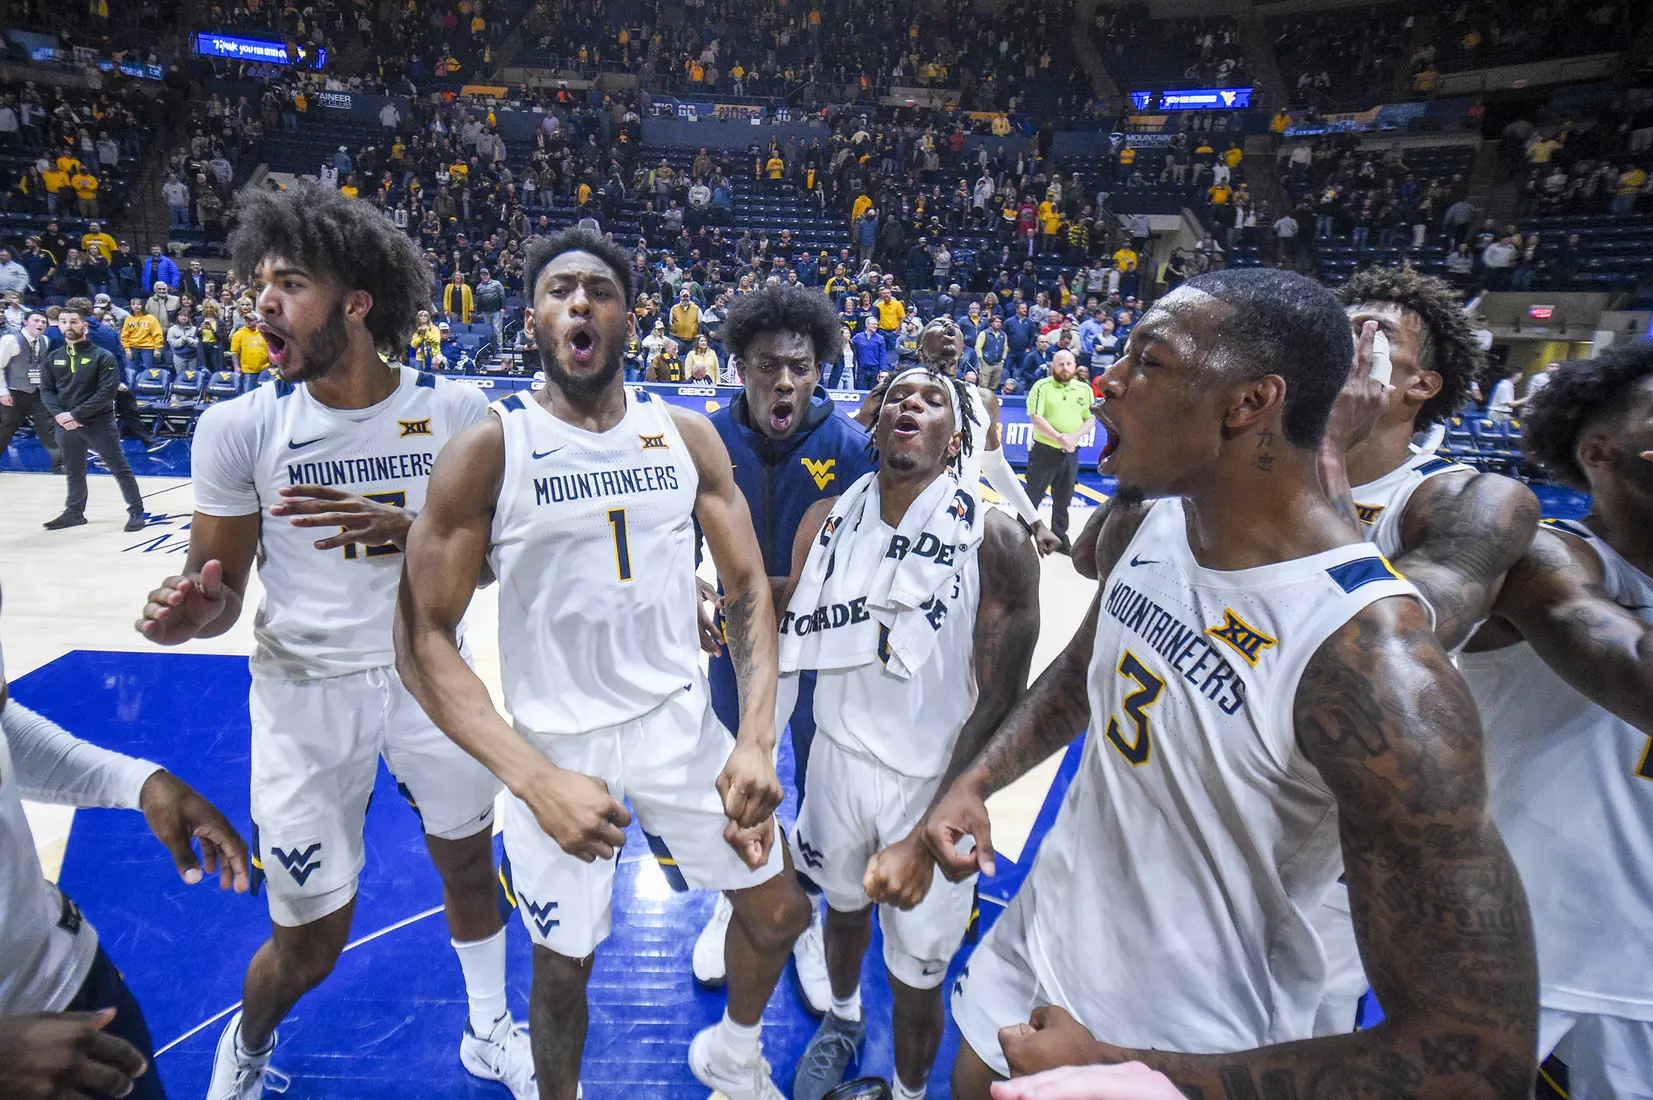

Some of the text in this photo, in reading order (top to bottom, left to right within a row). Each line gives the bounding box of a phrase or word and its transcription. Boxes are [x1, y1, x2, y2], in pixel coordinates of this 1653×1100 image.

[678, 387, 716, 396] GEICO
[288, 453, 433, 486] MOUNTAINEERS
[533, 465, 678, 506] MOUNTAINEERS
[606, 507, 633, 582] 1
[1105, 580, 1246, 715] MOUNTAINEERS
[1205, 608, 1279, 667] XII
[1106, 649, 1167, 767] 3
